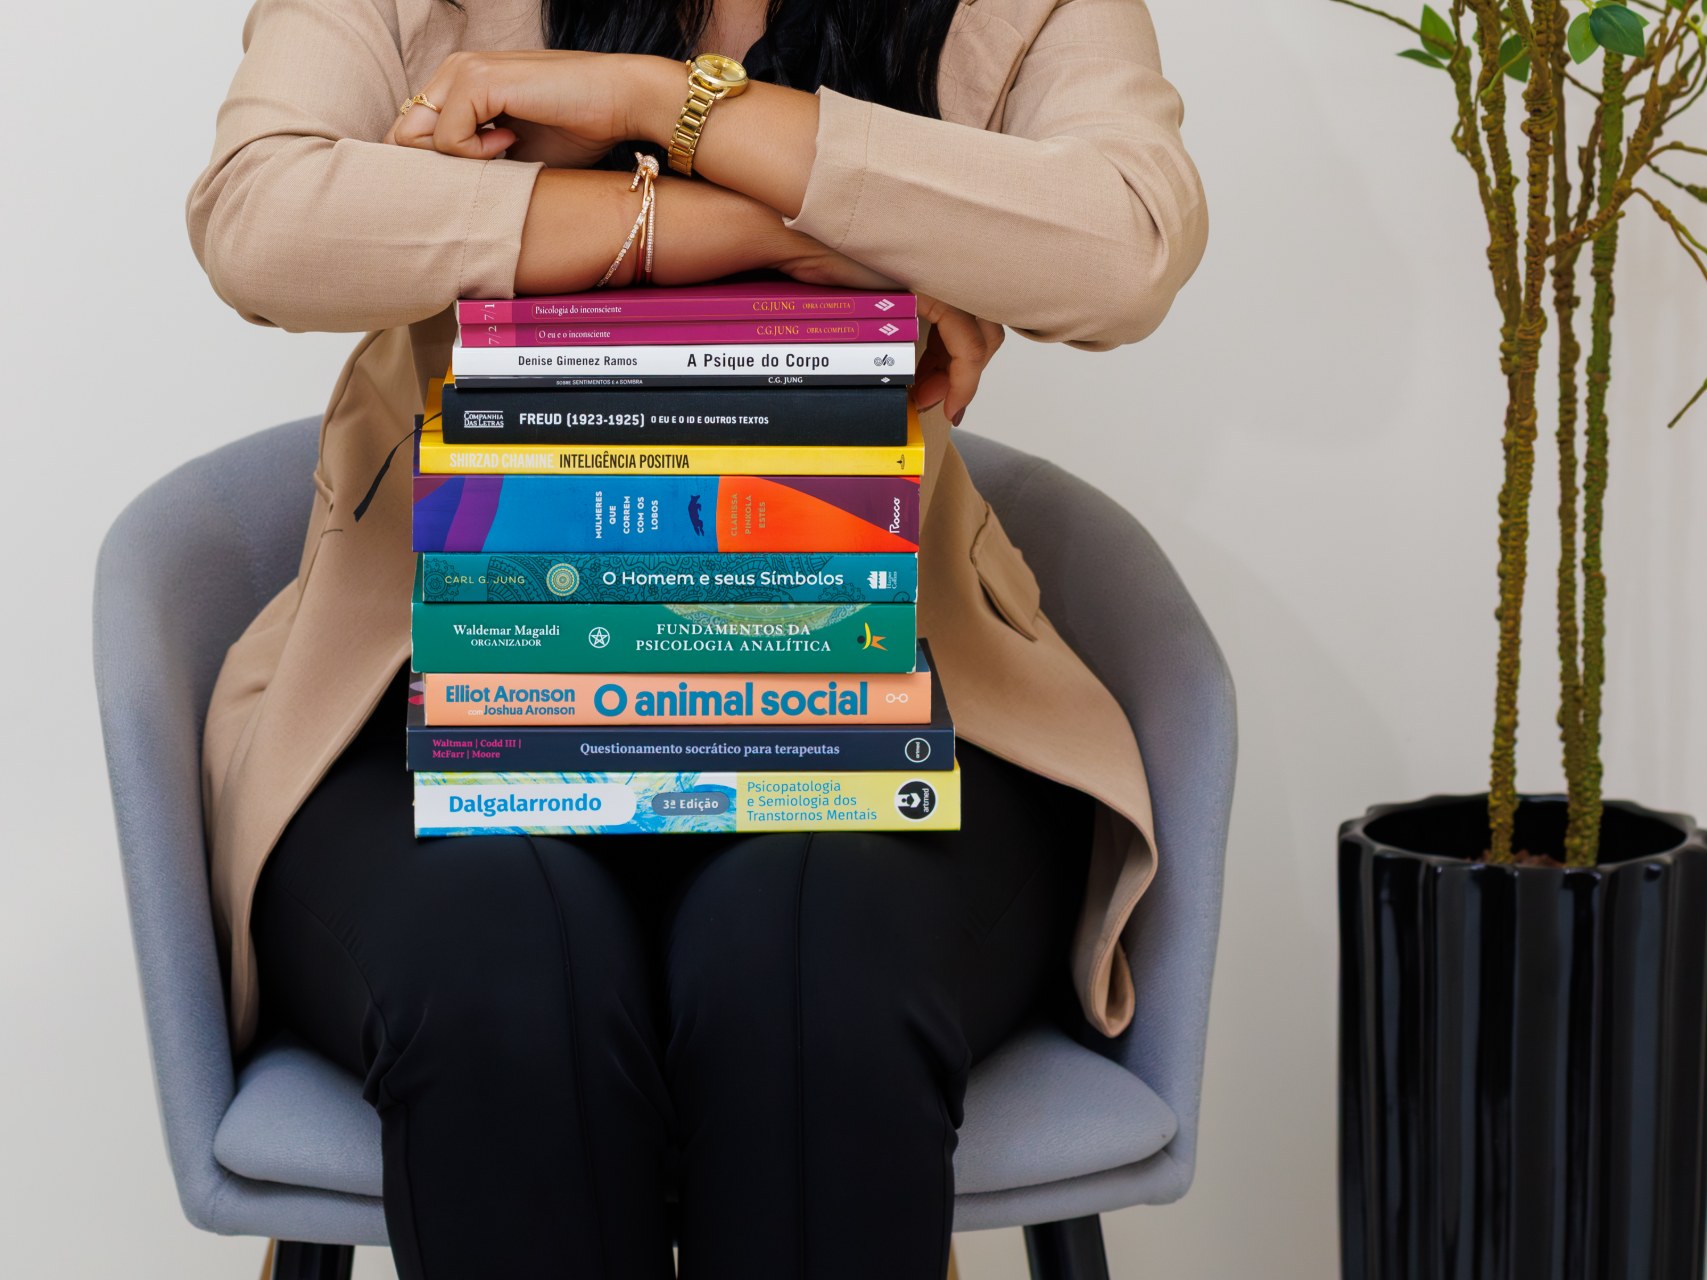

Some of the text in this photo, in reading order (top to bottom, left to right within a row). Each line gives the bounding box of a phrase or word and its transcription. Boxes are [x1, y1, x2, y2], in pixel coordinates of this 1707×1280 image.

[535, 304, 622, 316] Psicologia do inconsciente
[538, 330, 546, 339] O
[569, 330, 611, 338] inconsciente
[518, 355, 638, 366] Denise Gimenez Ramos
[687, 353, 830, 370] A Psique do Corpo
[783, 376, 803, 384] JUNG
[519, 413, 562, 425] FREUD
[566, 413, 645, 427] (1923-1925)
[704, 416, 737, 424] OUTROS
[738, 416, 769, 425] TEXTOS
[450, 453, 554, 468] SHIRZAD CHAMINE
[560, 451, 689, 468] INTELIGÊNCIA POSITIVA
[637, 496, 644, 509] OS
[889, 497, 900, 533] Rocco
[445, 576, 525, 584] CARL G. JUNG
[602, 571, 844, 586] O Homem e seus Símbolos
[453, 624, 560, 638] Waldemar Magaldi
[656, 624, 811, 636] FUNDAMENTOS DA
[471, 638, 542, 647] ORGANIZADOR
[636, 638, 831, 652] PSICOLOGIA ANALÍTICA
[446, 685, 575, 703] Elliot Aronson
[593, 681, 868, 717] O animal social
[483, 705, 523, 716] Joshua
[525, 705, 575, 715] Aronson
[433, 739, 473, 748] Waltman
[480, 739, 502, 748] Codd
[580, 742, 840, 757] Questionamento socrático para terapeutas
[433, 750, 464, 759] McFarr
[472, 750, 500, 759] Moore
[747, 780, 841, 794] Psicopatologia
[450, 793, 602, 817] Dalgalarrondo
[663, 798, 719, 811] 3ª Edição
[747, 795, 857, 808] e Semiologia dos
[747, 808, 877, 821] Transtornos Mentais
